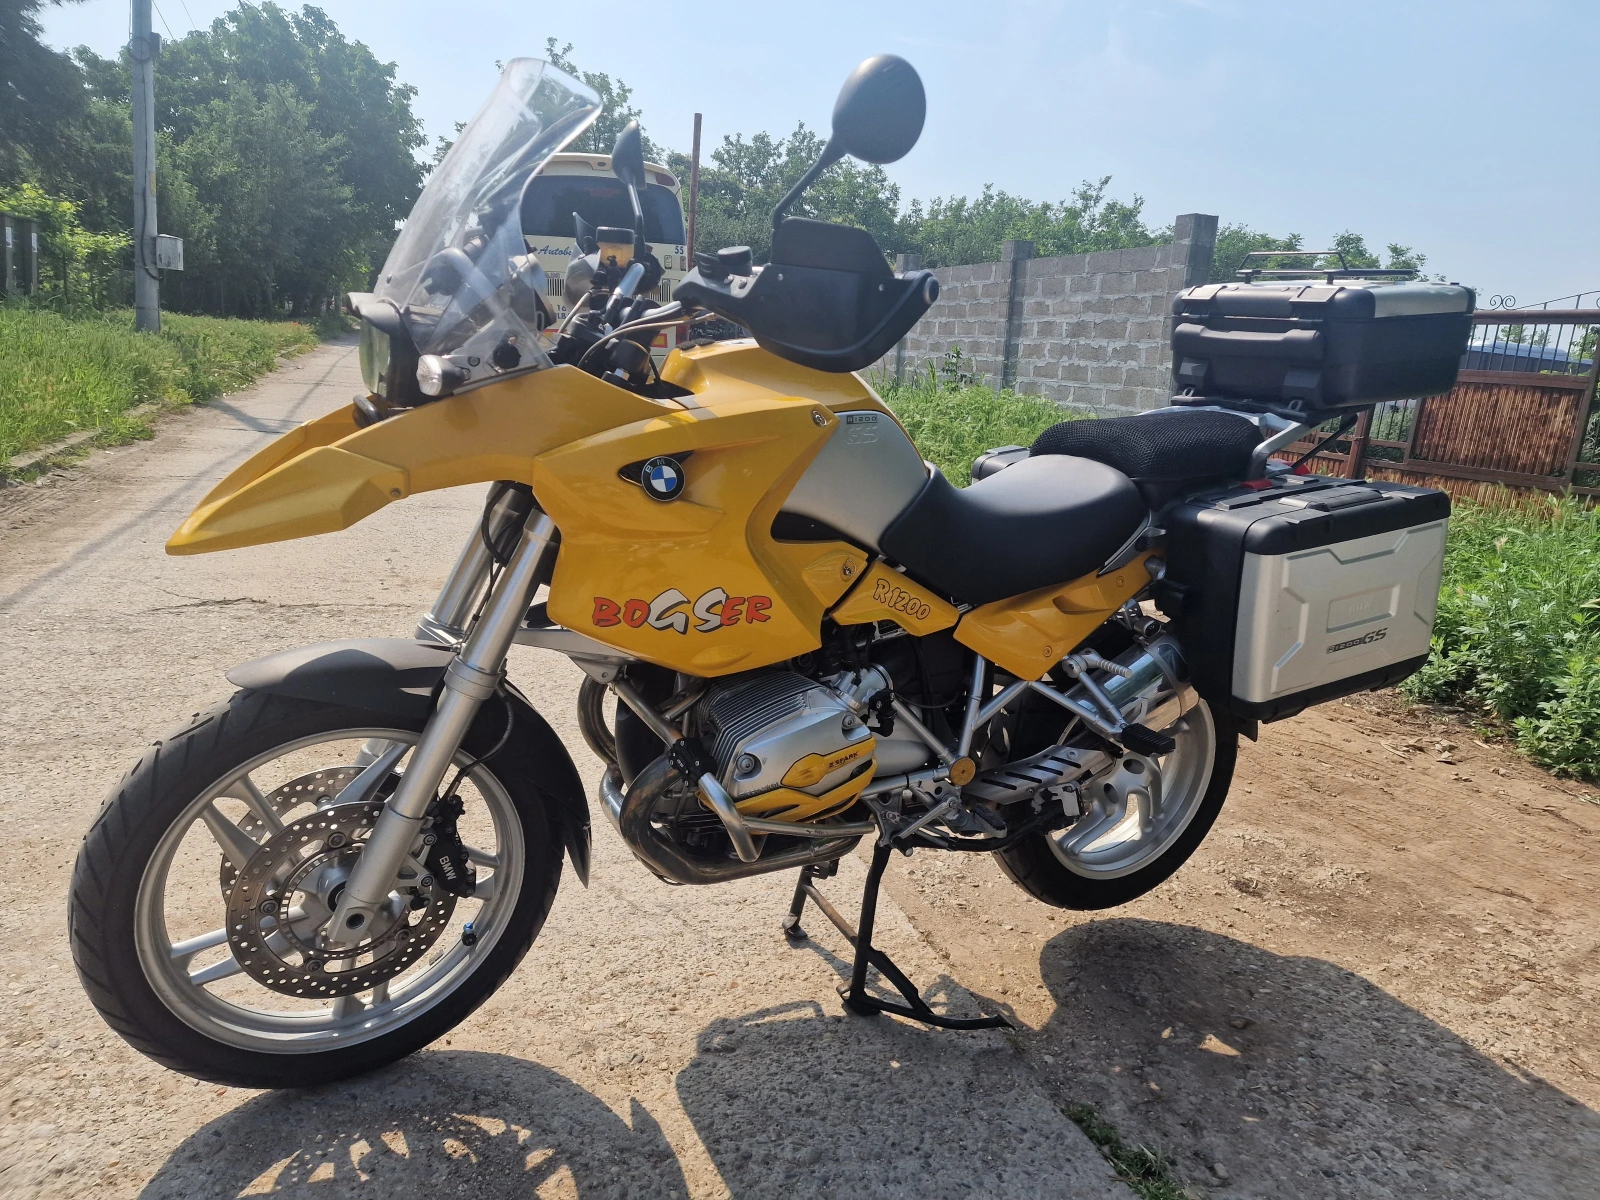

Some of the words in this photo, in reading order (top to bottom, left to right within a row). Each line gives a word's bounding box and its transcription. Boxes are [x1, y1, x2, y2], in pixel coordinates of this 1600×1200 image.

[674, 245, 684, 255] 55
[592, 586, 773, 635] BOGSER
[439, 855, 457, 881] BMW
